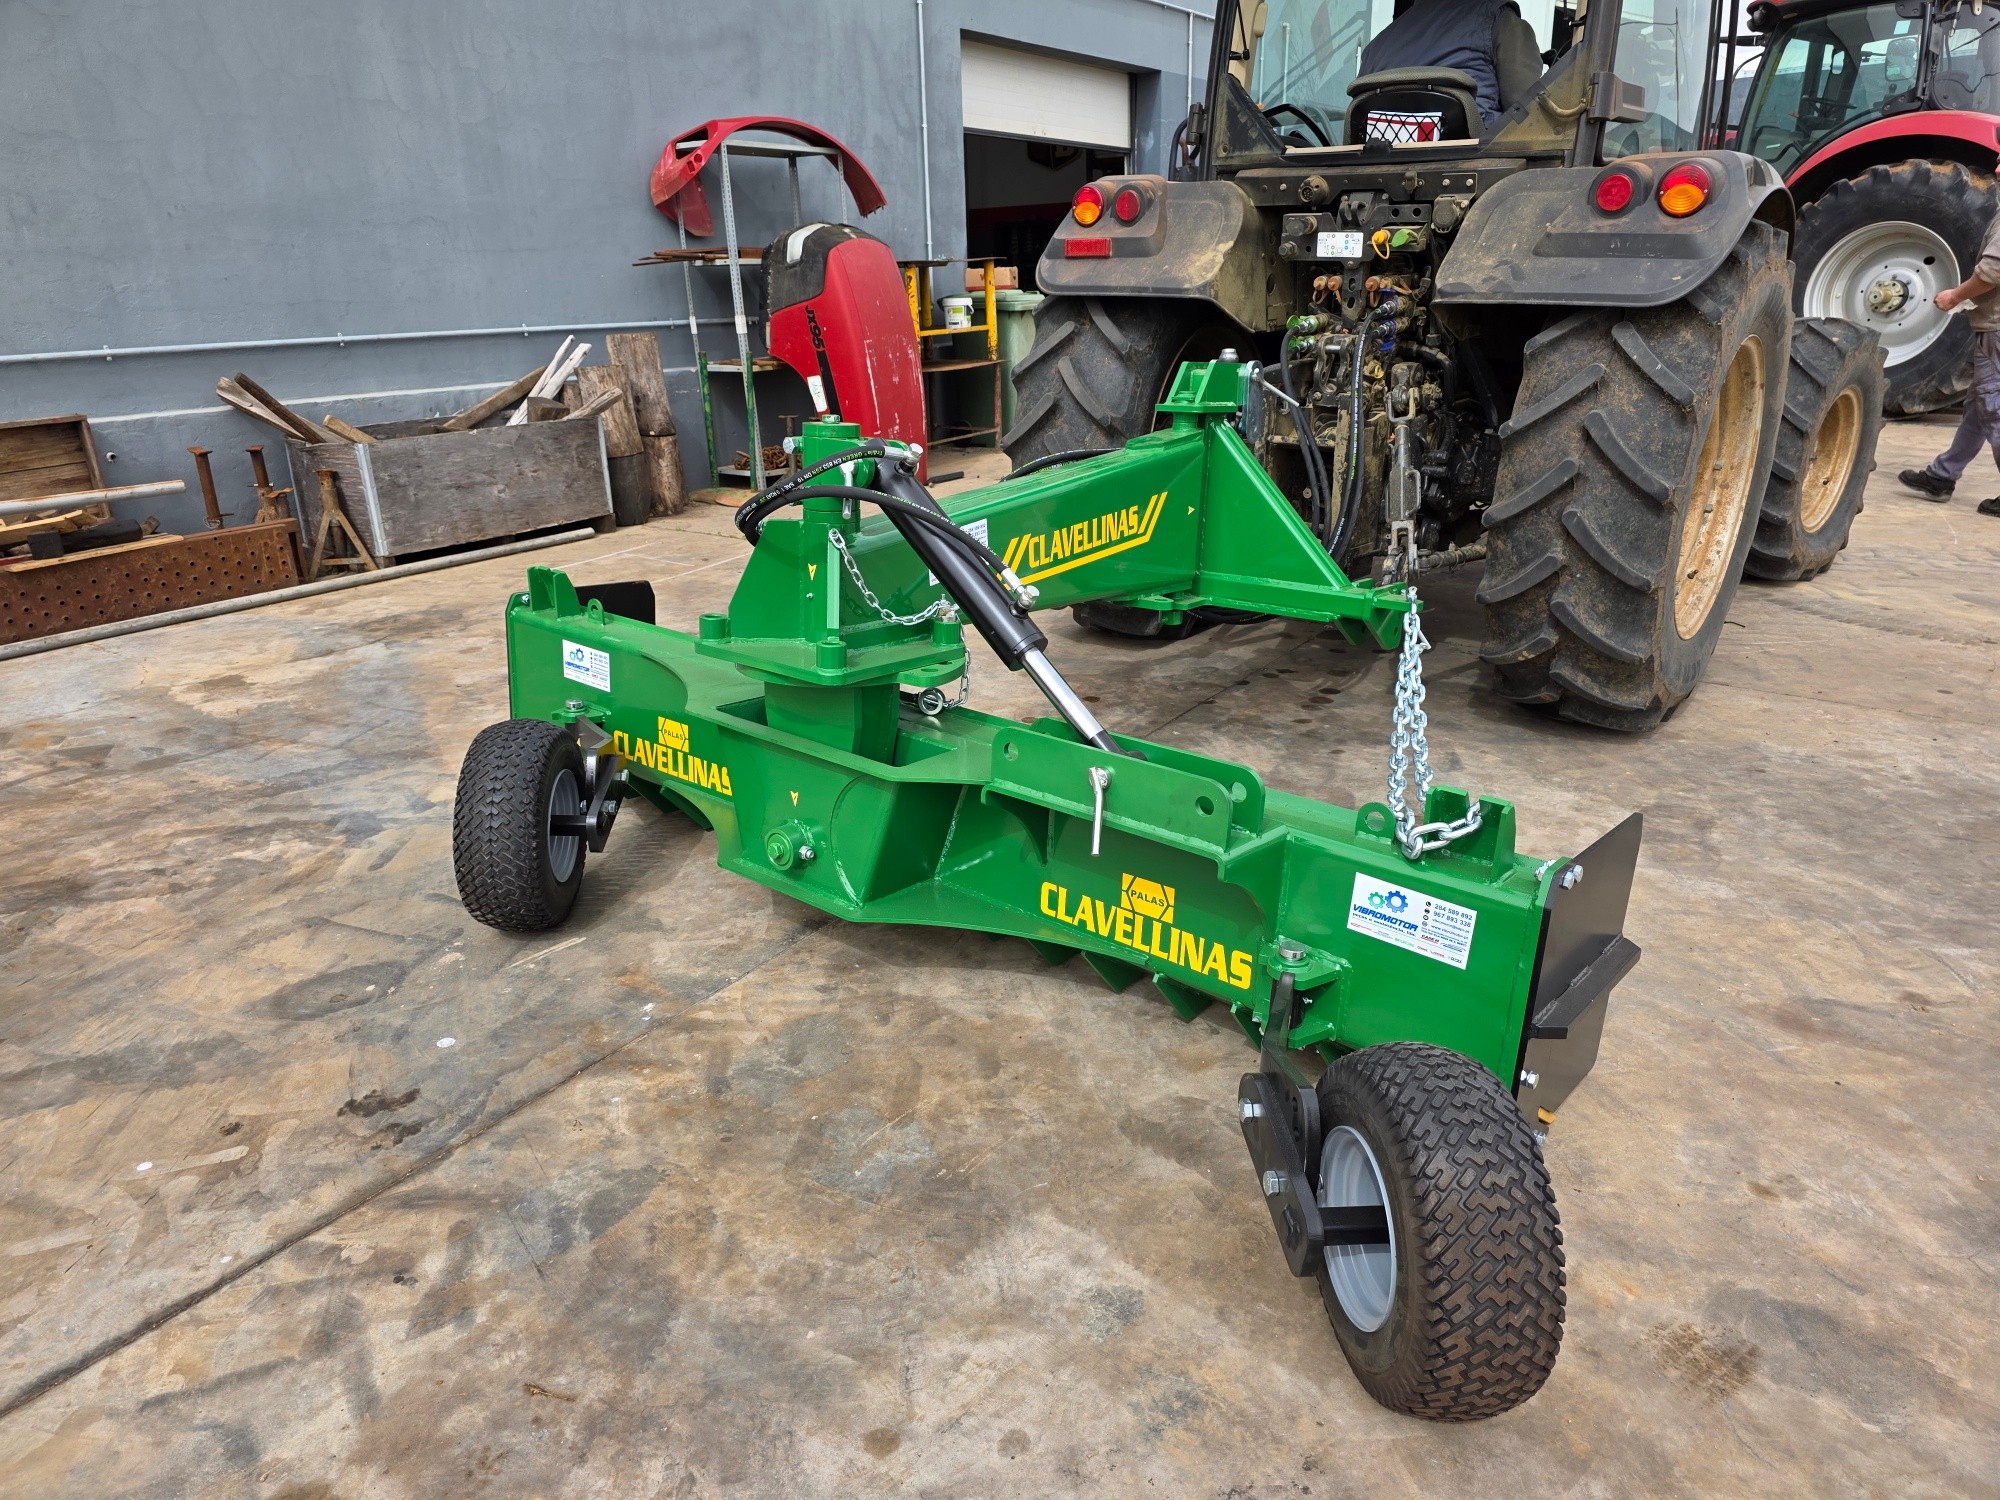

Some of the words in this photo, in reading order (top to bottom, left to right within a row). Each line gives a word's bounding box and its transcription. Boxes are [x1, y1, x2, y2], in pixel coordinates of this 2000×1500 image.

[804, 305, 826, 350] JX95
[1028, 505, 1139, 568] CLAVELLINAS
[663, 728, 684, 741] PALAS
[613, 729, 733, 796] CLAVELLINAS
[1130, 889, 1166, 907] PALAS
[1353, 903, 1419, 932] VIBROMOTOR
[1040, 881, 1253, 990] CLAVELLINAS
